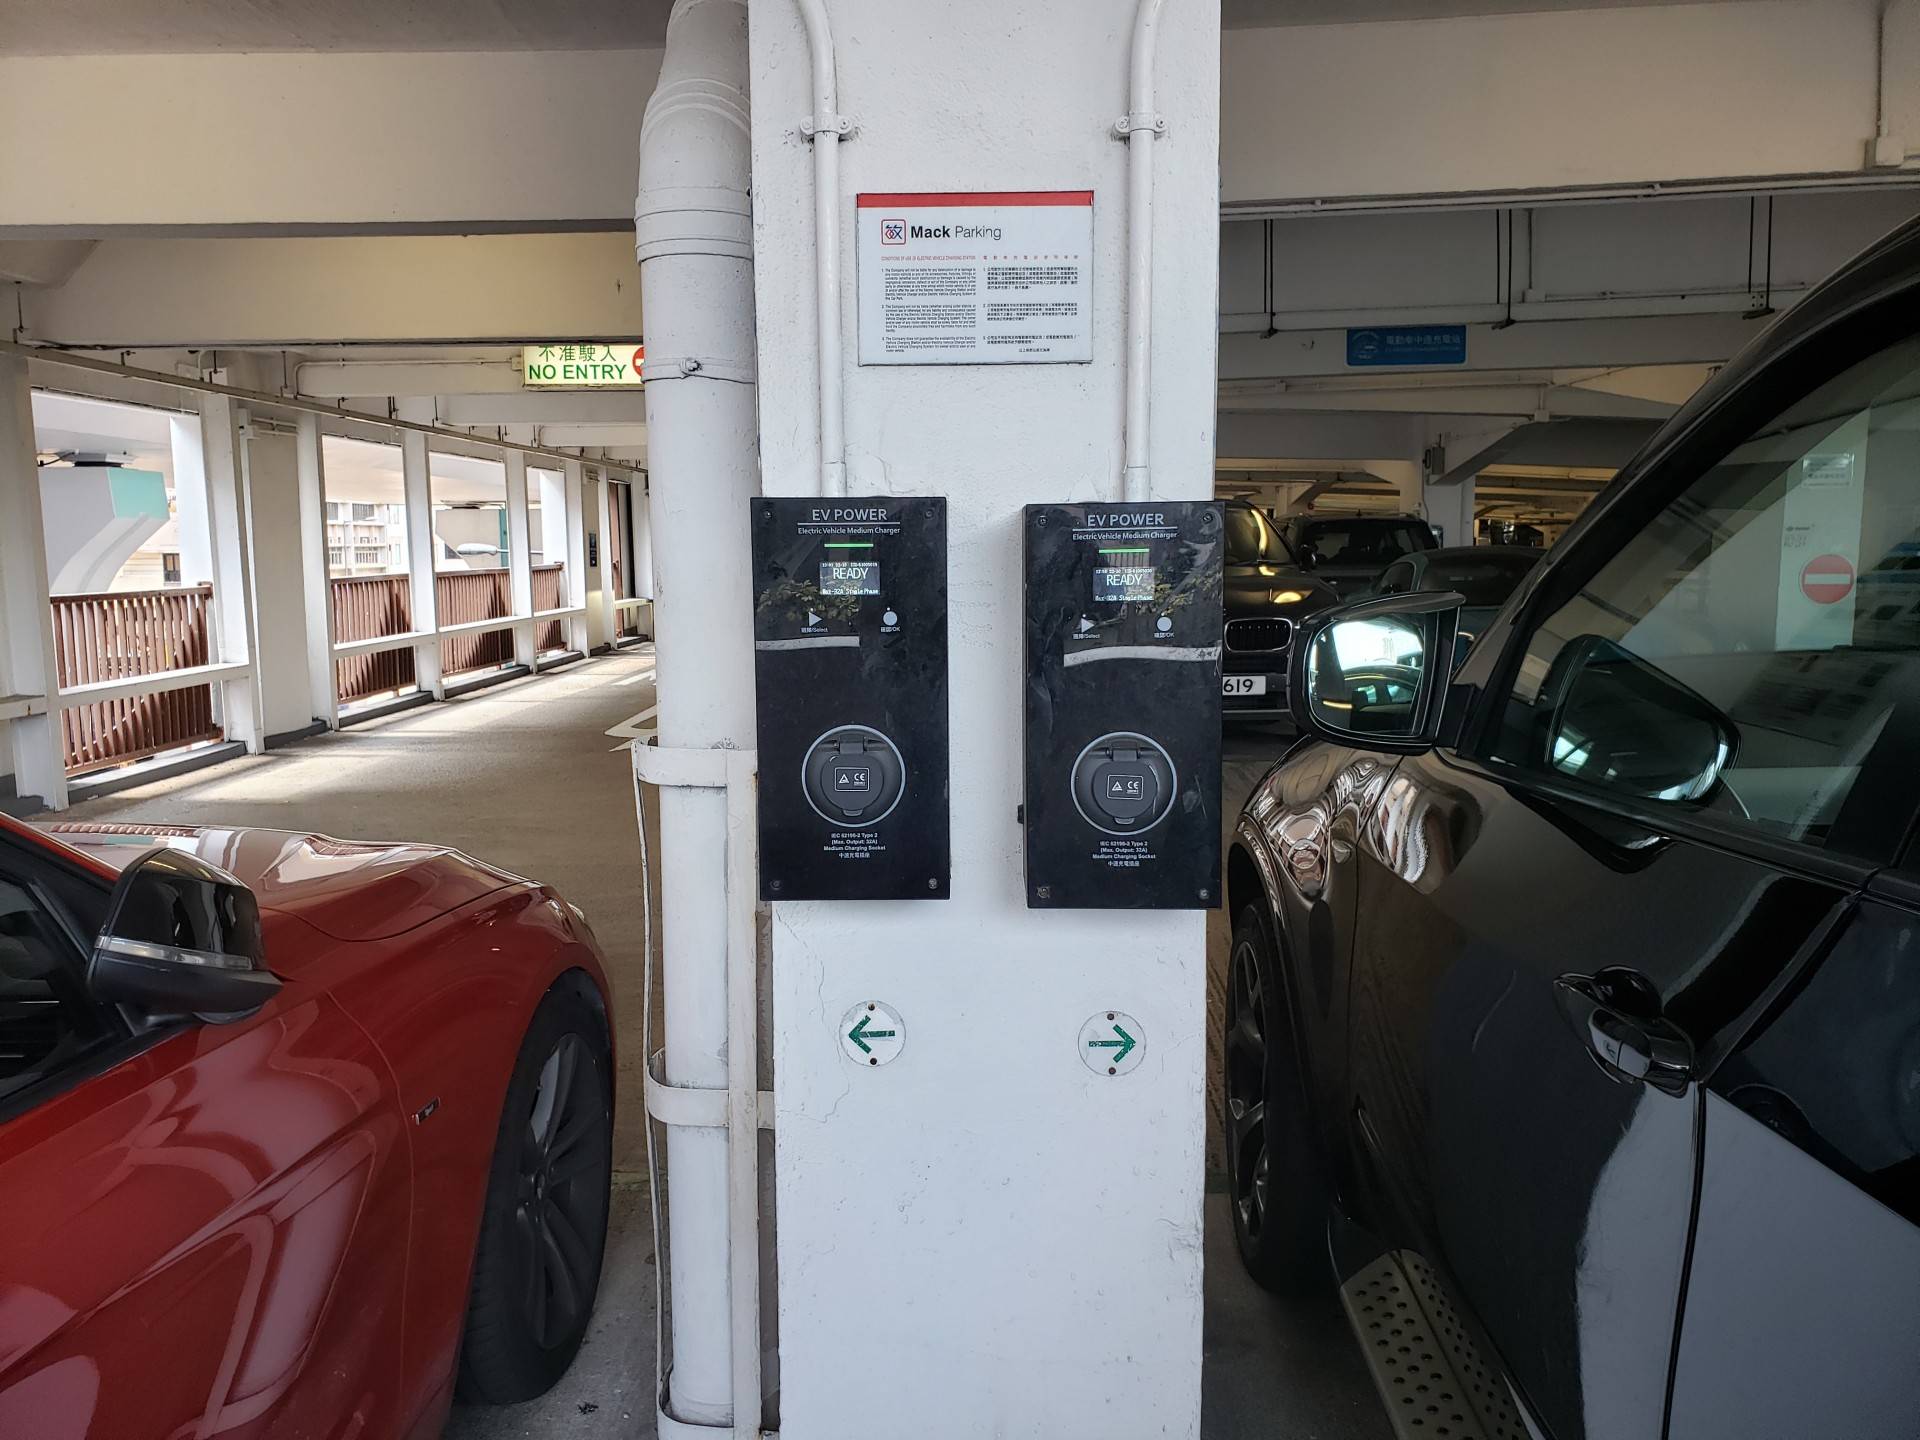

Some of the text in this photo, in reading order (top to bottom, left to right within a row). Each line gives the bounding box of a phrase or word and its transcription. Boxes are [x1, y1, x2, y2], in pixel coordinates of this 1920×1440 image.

[911, 225, 1002, 241] Mack Parking
[538, 344, 617, 362] 不准駛入
[529, 364, 627, 380] NO ENTRY
[812, 508, 888, 521] EV POWER
[1087, 513, 1164, 527] EV POWER
[798, 526, 901, 536] Electric Vehicle Medium Charger
[1072, 533, 1098, 541] Electric
[1122, 532, 1150, 540] Medium
[1150, 531, 1178, 540] Charger
[833, 567, 869, 580] READY
[1106, 574, 1143, 586] READY
[1223, 678, 1254, 693] 619
